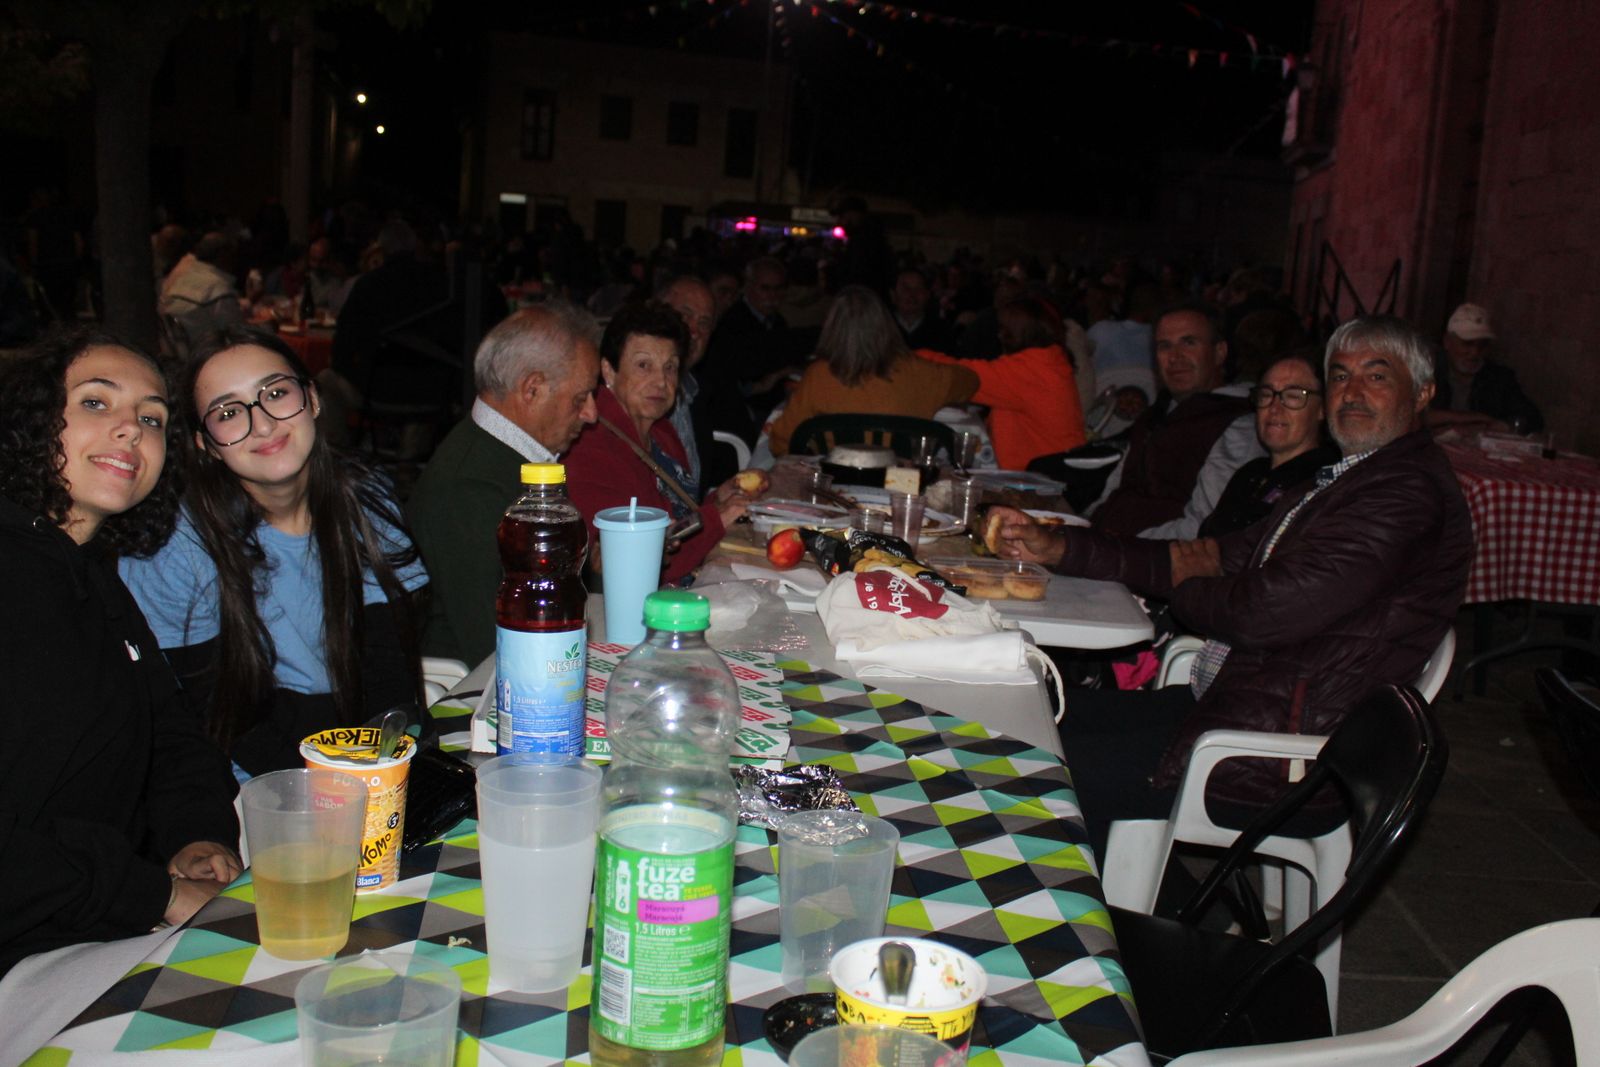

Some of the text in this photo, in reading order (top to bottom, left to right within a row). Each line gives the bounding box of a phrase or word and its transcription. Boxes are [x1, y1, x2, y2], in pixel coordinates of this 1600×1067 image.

[867, 596, 878, 609] 19
[311, 728, 381, 746] TEKOMO
[592, 740, 612, 752] EM
[358, 833, 392, 868] KOMO
[637, 857, 696, 883] fuze
[357, 876, 380, 886] Blanca
[636, 880, 681, 901] tea
[635, 922, 648, 935] 1,5
[651, 924, 677, 936] Litros
